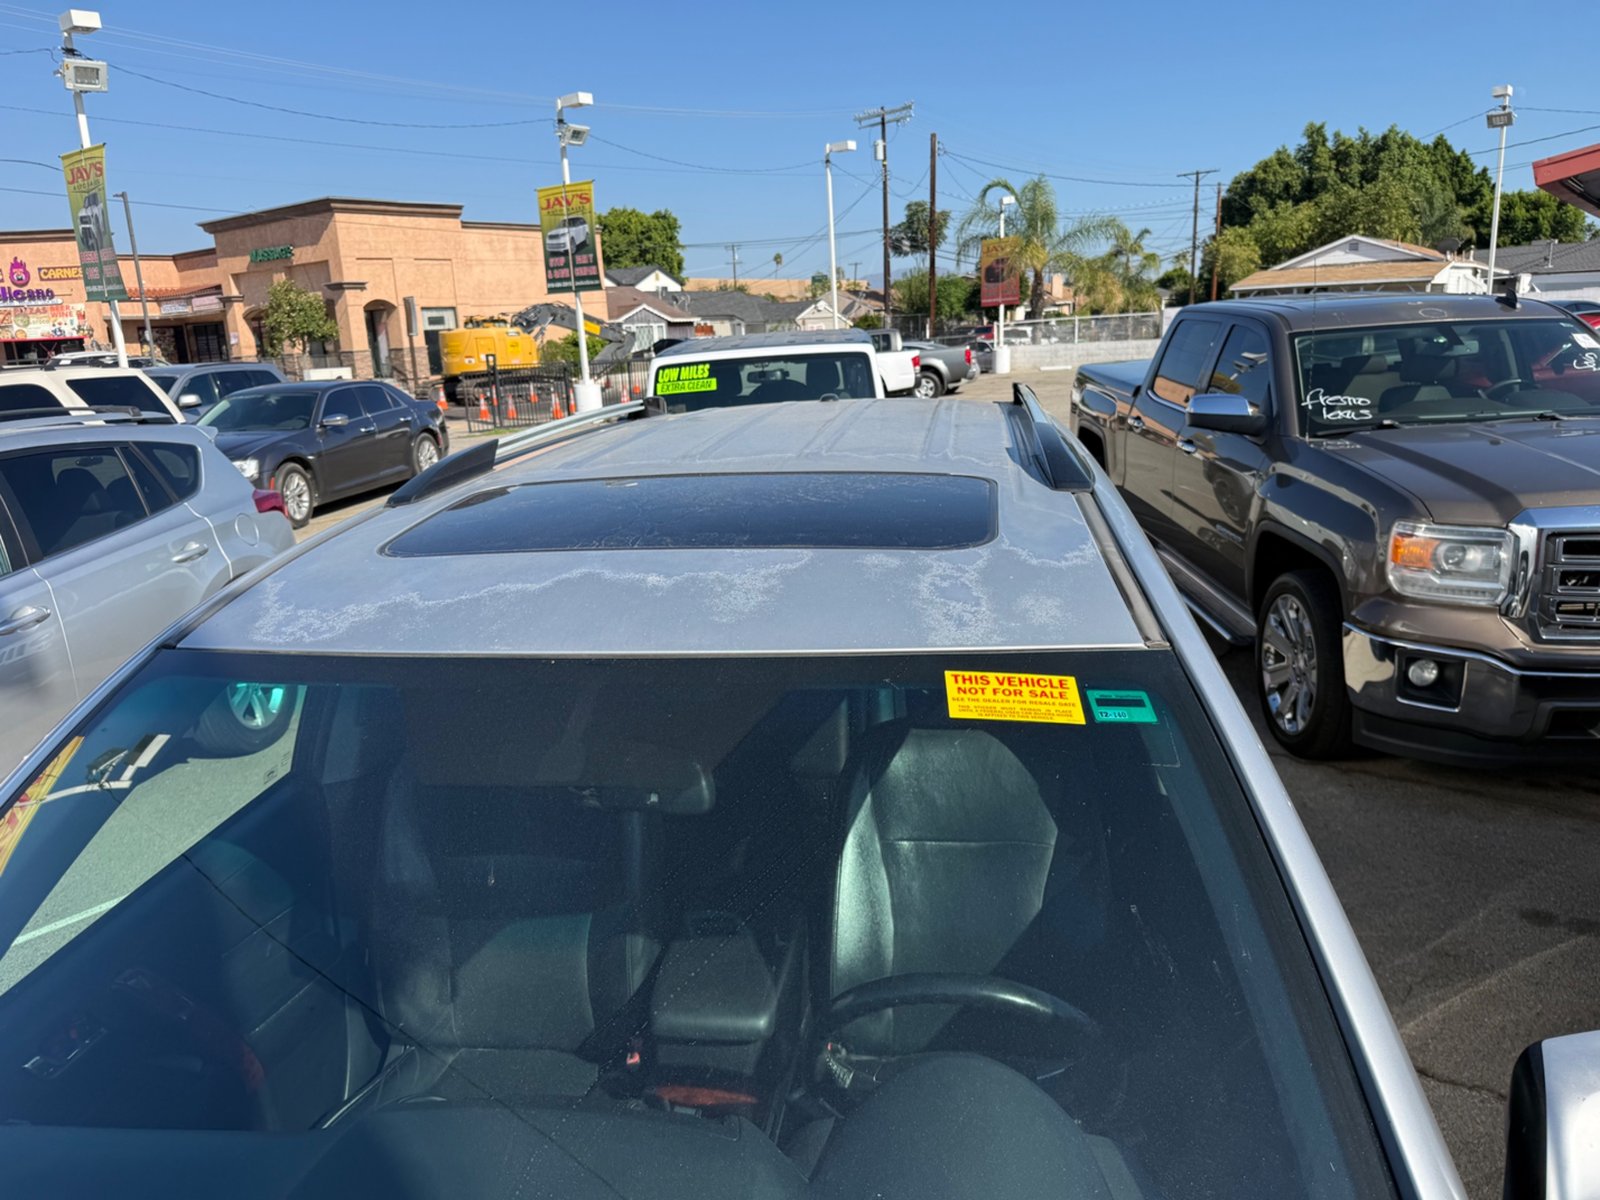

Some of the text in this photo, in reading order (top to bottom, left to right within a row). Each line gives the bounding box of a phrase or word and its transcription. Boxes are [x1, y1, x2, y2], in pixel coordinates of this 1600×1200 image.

[658, 363, 711, 383] LOW MILES
[661, 380, 713, 393] EXTRA CLEAN
[951, 674, 1070, 690] THIS VEHICLE
[957, 687, 1069, 700] NOT FOR SALE
